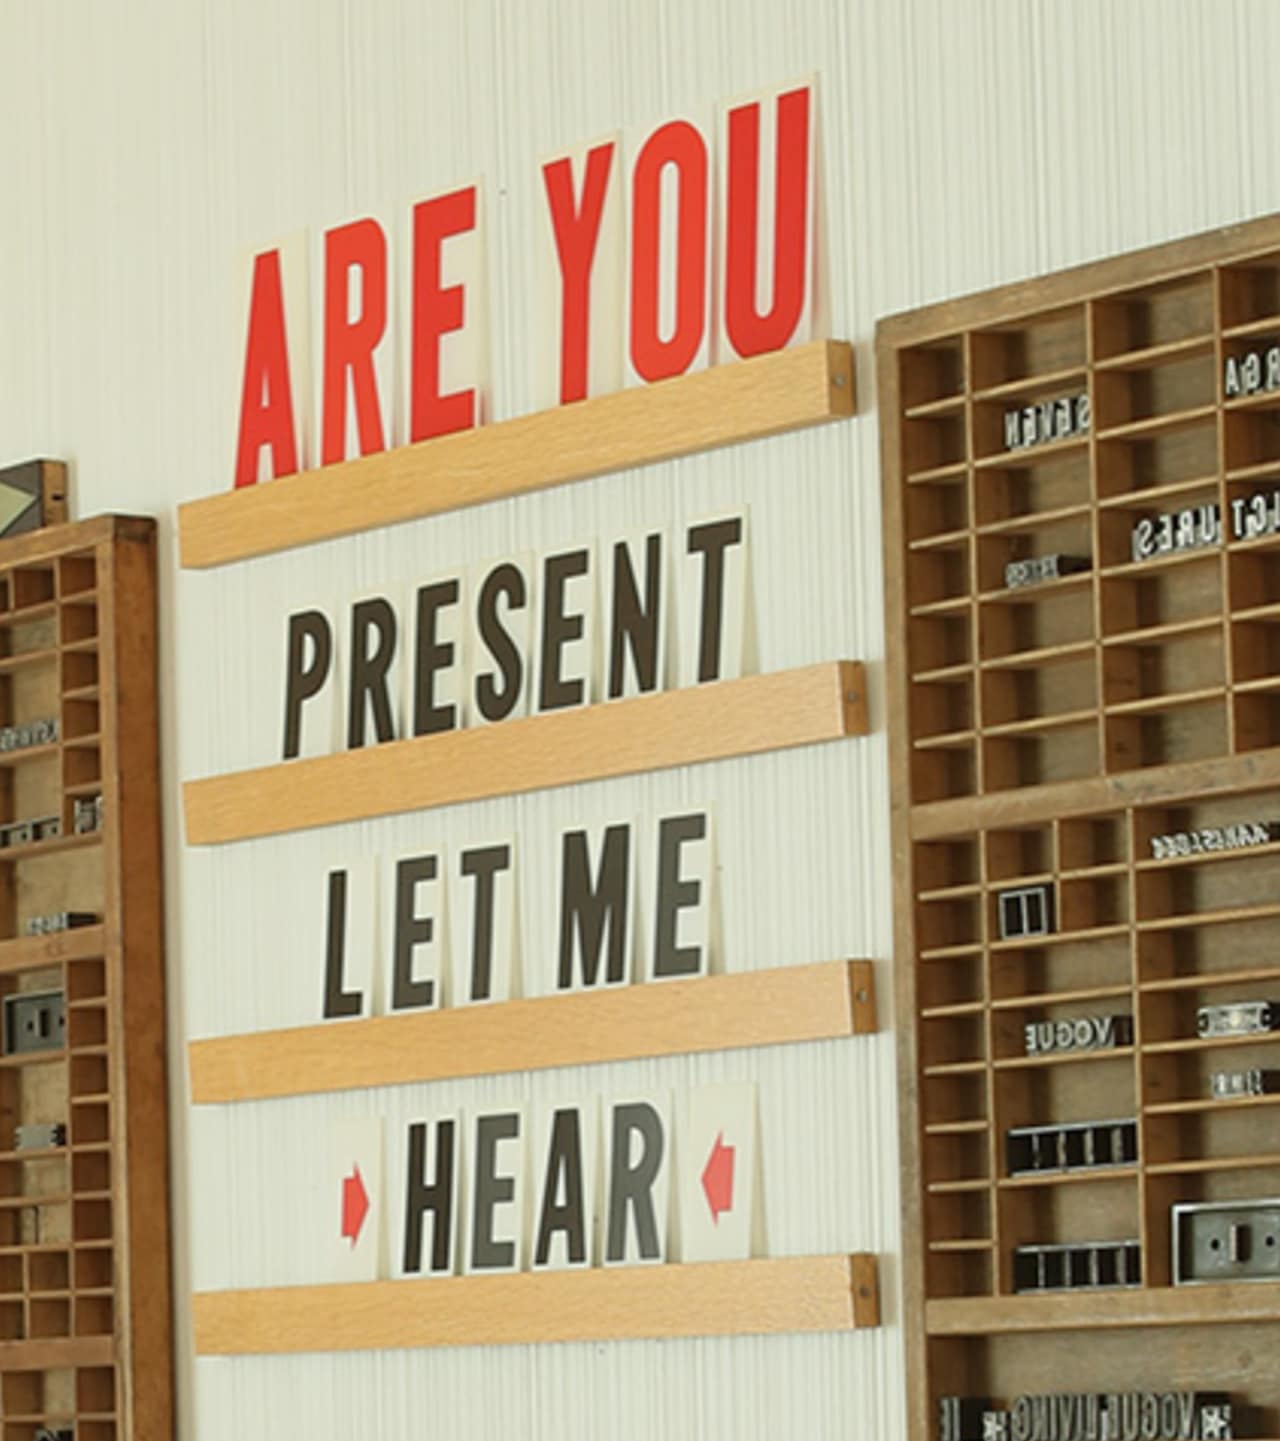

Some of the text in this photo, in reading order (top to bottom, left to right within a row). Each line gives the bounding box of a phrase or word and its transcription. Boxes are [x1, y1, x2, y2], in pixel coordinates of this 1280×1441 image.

[233, 86, 810, 490] ARE YOU
[281, 516, 743, 761] PRESENT
[321, 812, 707, 1020] LET ME
[401, 1101, 664, 1274] HEAR
